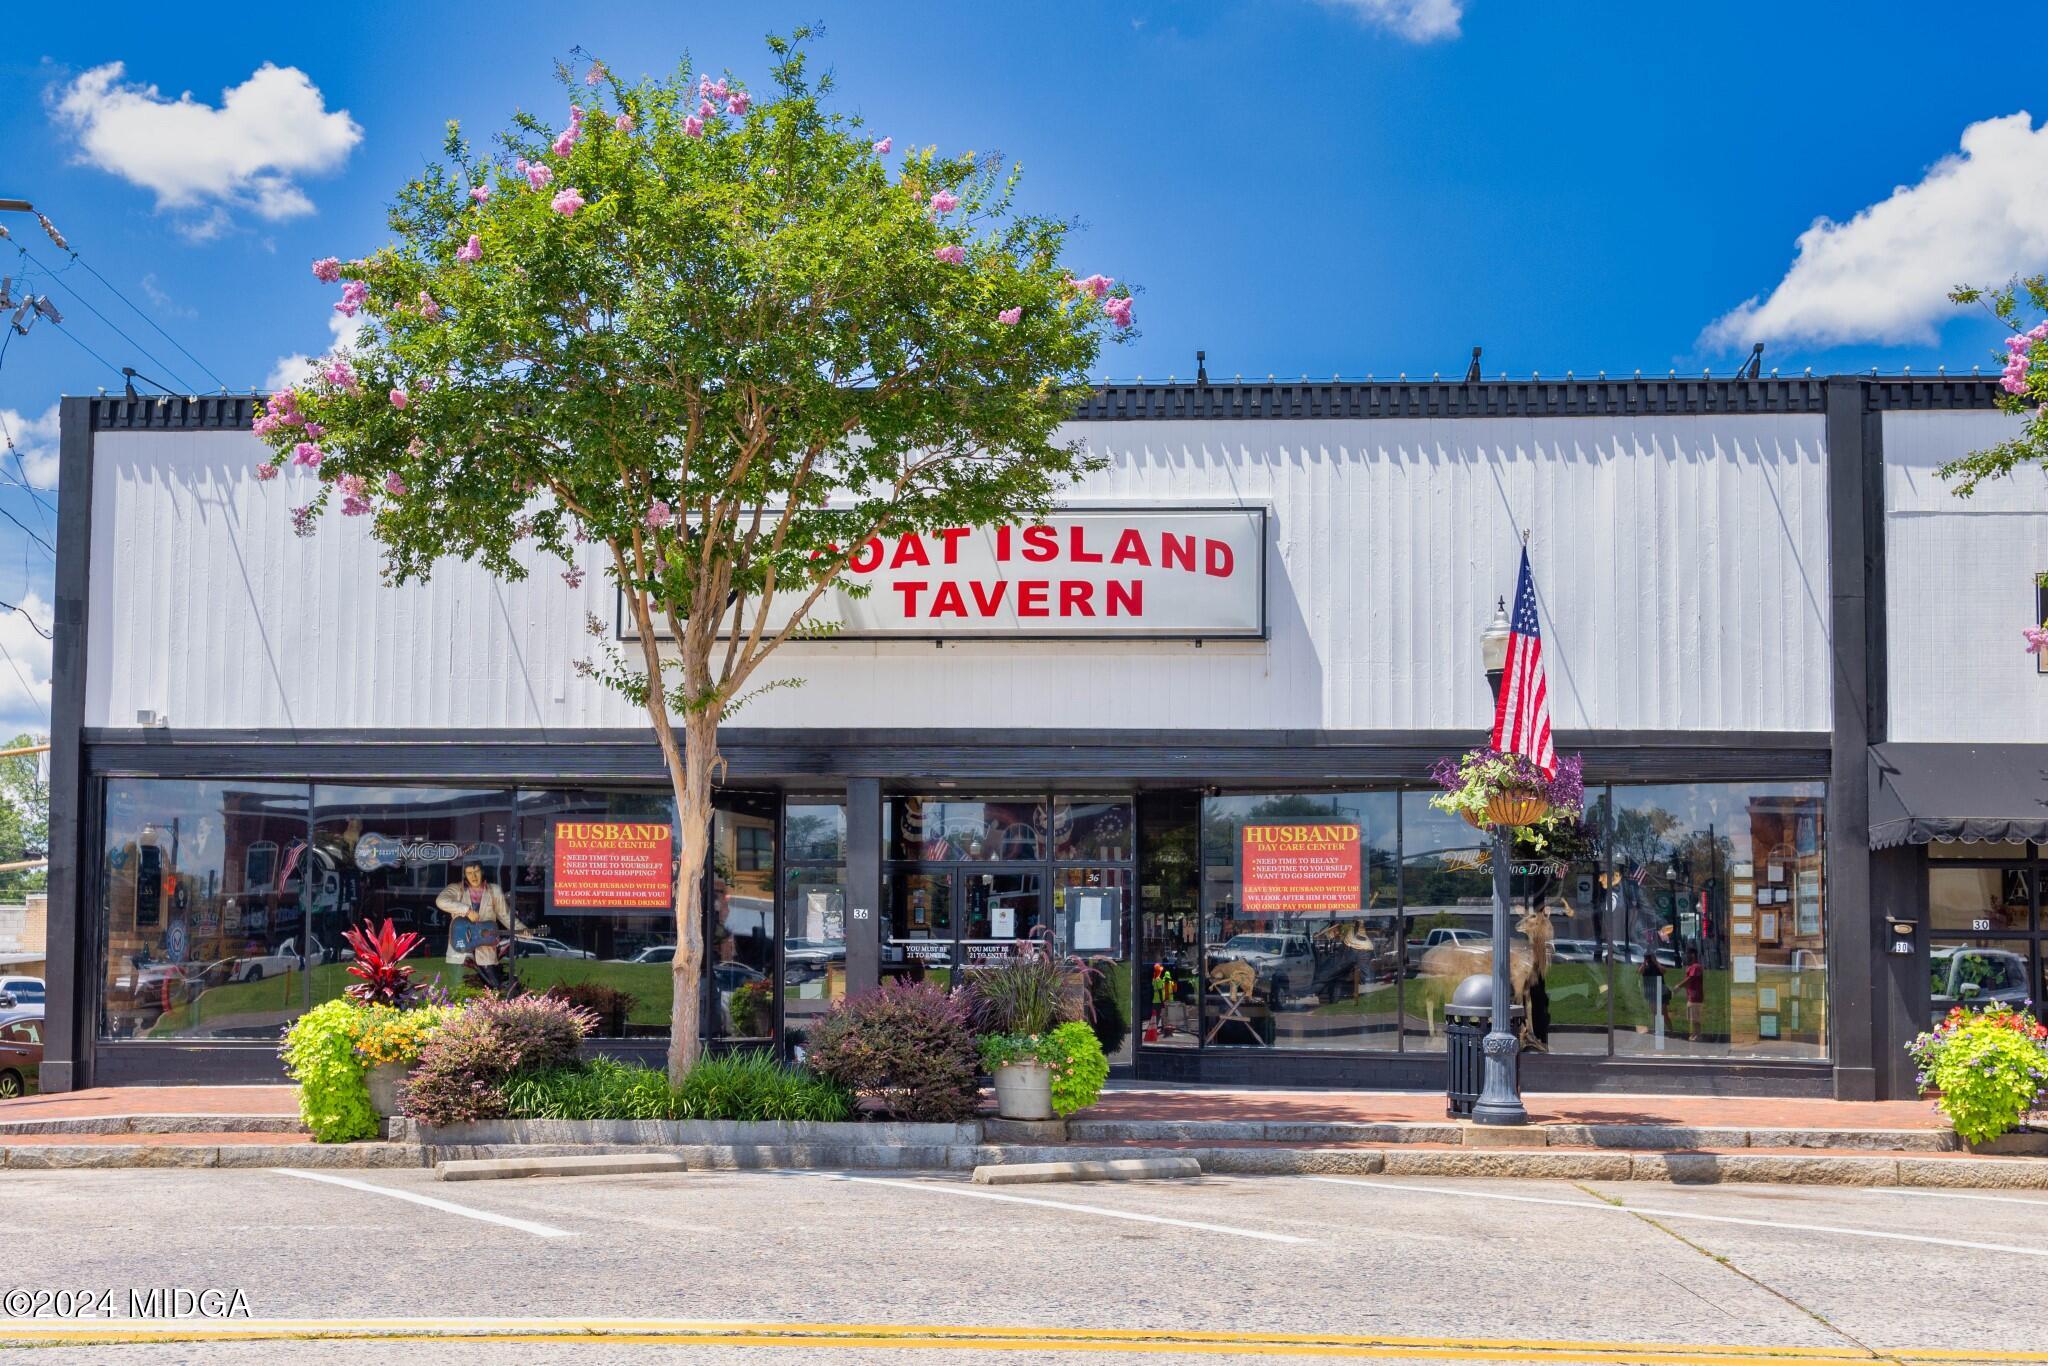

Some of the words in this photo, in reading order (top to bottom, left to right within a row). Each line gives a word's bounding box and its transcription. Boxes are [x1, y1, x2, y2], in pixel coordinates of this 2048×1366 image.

[997, 526, 1234, 578] ISLAND
[893, 580, 1143, 618] TAVERN
[557, 824, 669, 840] HUSBAND
[931, 824, 990, 841] OPEN
[1245, 826, 1358, 842] HUSBAND
[397, 843, 459, 861] MGD
[618, 841, 656, 849] CENTER
[1479, 863, 1528, 875] Geine
[1528, 863, 1558, 875] Draft
[1087, 874, 1100, 882] 36
[854, 910, 868, 918] 36
[1974, 921, 1989, 929] 30
[1897, 943, 1907, 951] 30
